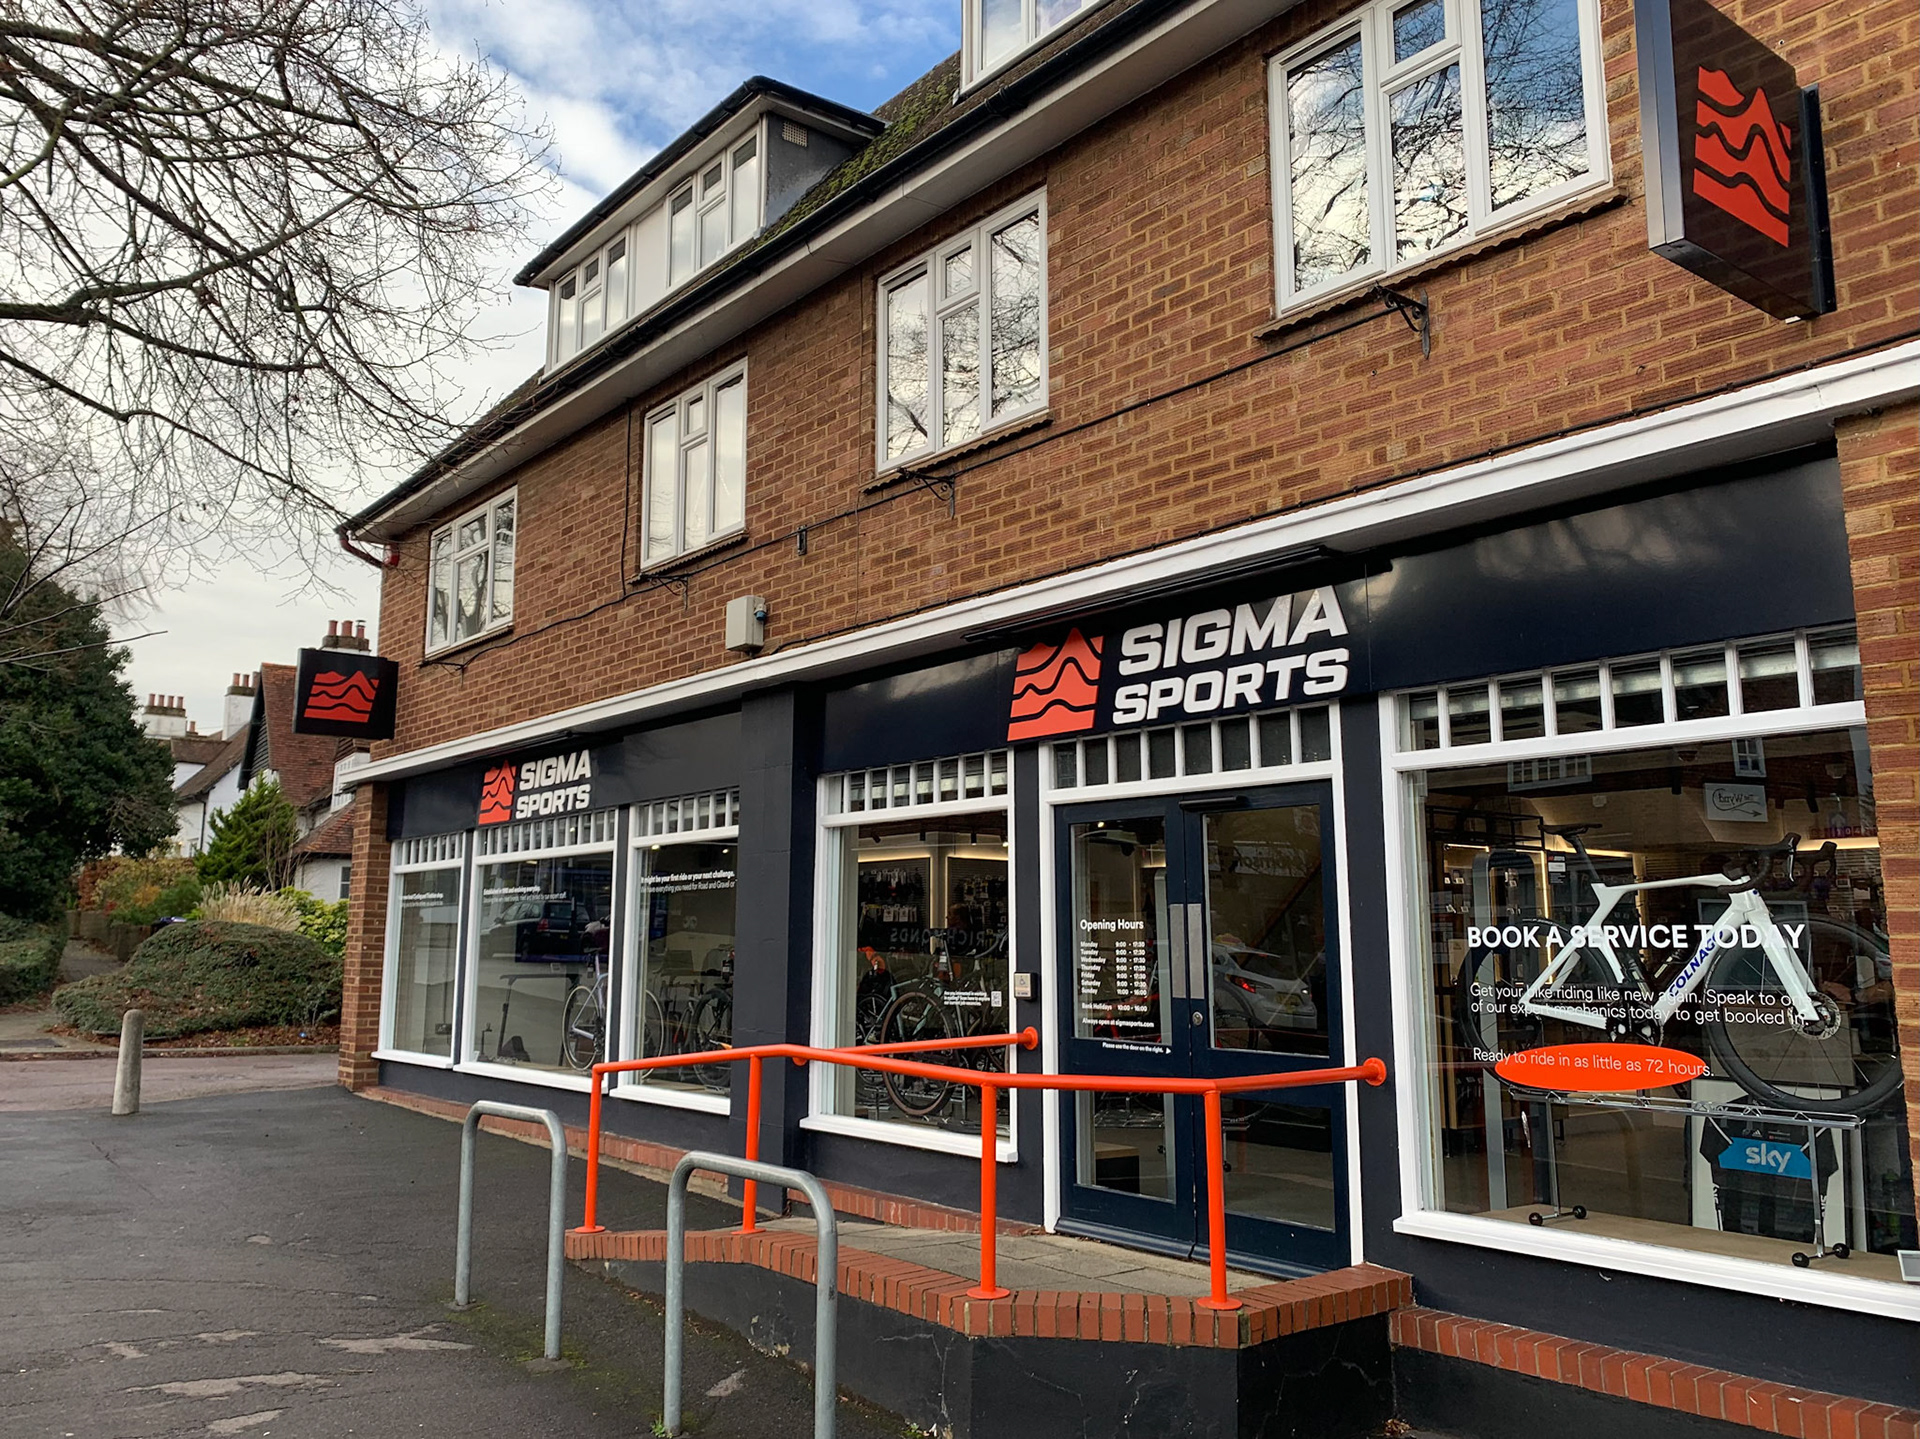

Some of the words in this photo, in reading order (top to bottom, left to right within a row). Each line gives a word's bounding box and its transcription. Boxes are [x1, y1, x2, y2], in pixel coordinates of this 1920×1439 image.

[1118, 585, 1349, 677] SIGMA
[1113, 648, 1349, 725] SPORTS
[519, 749, 591, 791] SIGMA
[516, 784, 591, 819] SPORTS
[656, 883, 674, 893] everything
[698, 882, 708, 890] Road
[717, 880, 729, 889] Gravel
[712, 870, 735, 879] challenge.
[1080, 919, 1116, 932] Opening
[1117, 919, 1144, 930] Hours
[1467, 926, 1540, 948] BOOK
[1546, 925, 1565, 948] A
[1570, 925, 1689, 948] SERVICE
[1694, 924, 1805, 949] TODAY
[1669, 931, 1723, 998] COLNAGO
[1081, 987, 1098, 995] Sunday
[1470, 984, 1493, 997] Get
[1496, 986, 1523, 1000] your
[1526, 985, 1553, 998] bike
[1556, 985, 1593, 1003] riding
[1597, 986, 1620, 1001] like
[1624, 990, 1654, 1002] new
[1658, 990, 1702, 1006] again.
[1706, 989, 1755, 1007] Speak
[1759, 991, 1776, 1006] to
[1092, 1003, 1112, 1011] Holidays
[1470, 1000, 1484, 1013] of
[1486, 1002, 1506, 1013] our
[1510, 1003, 1549, 1017] expet
[1630, 1007, 1670, 1023] today
[1675, 1008, 1691, 1021] to
[1694, 1010, 1720, 1025] get
[1724, 1008, 1784, 1025] booked
[1790, 1012, 1809, 1026] in.
[1082, 1018, 1098, 1026] Always
[1115, 1019, 1155, 1028] sigmasports.com
[1473, 1047, 1511, 1065] Ready
[1513, 1051, 1527, 1064] to
[1530, 1051, 1555, 1066] ride
[1558, 1052, 1570, 1067] in
[1574, 1056, 1589, 1068] as
[1593, 1054, 1622, 1070] little
[1626, 1059, 1642, 1072] as
[1645, 1058, 1664, 1073] 72
[1668, 1058, 1714, 1077] hours.
[1746, 1143, 1791, 1173] sky
